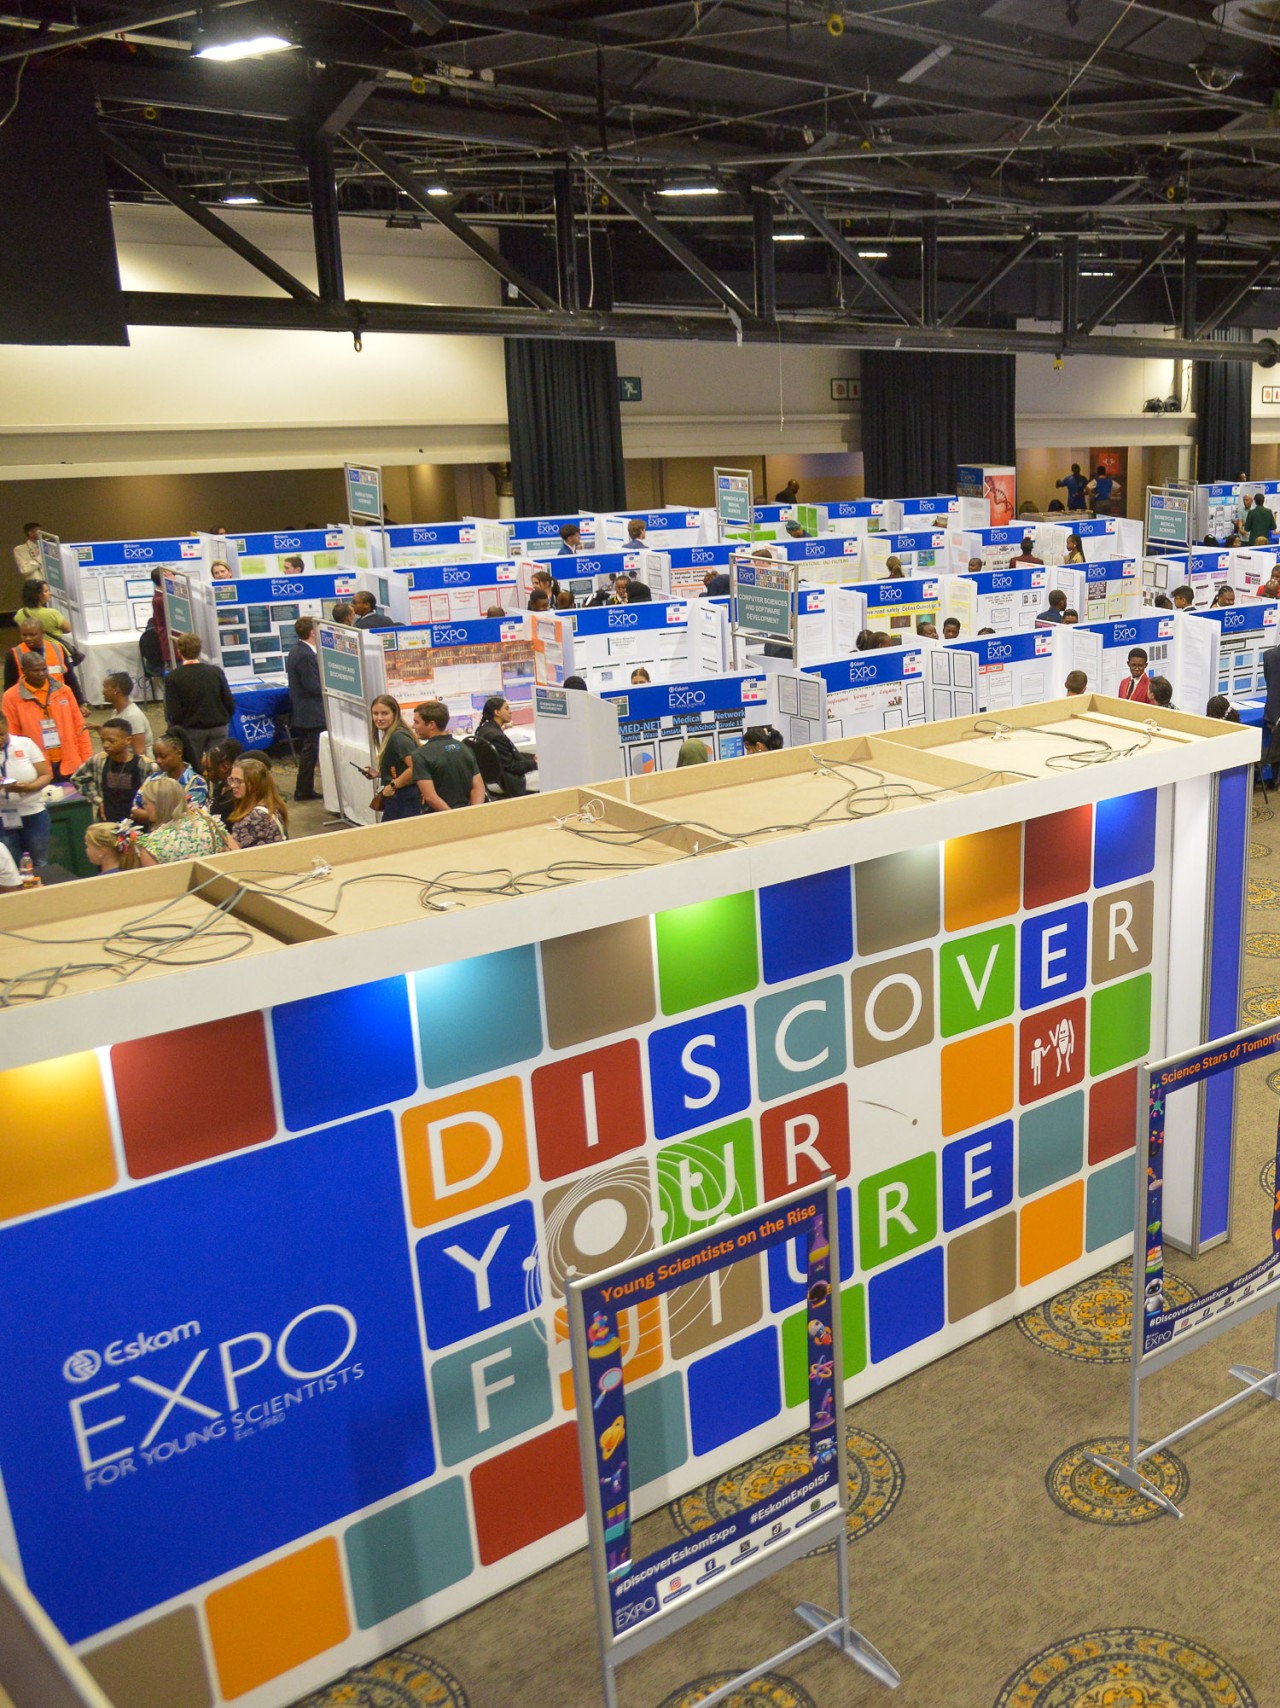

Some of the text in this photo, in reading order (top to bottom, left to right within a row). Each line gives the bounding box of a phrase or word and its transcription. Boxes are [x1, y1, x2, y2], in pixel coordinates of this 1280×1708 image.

[839, 505, 856, 515] EXPO
[919, 502, 935, 511] EXPO
[648, 517, 668, 527] EXPO
[537, 524, 560, 534] EXPO
[1078, 525, 1094, 534] EXPO
[413, 531, 438, 542] EXPO
[990, 532, 1009, 542] EXPO
[273, 538, 301, 549] EXPO
[897, 538, 916, 548] EXPO
[123, 547, 155, 559] EXPO
[805, 545, 826, 555] EXPO
[691, 551, 715, 562] EXPO
[576, 560, 601, 572] EXPO
[1088, 567, 1107, 577] EXPO
[443, 571, 471, 582] EXPO
[739, 571, 755, 580] EXPO
[992, 575, 1013, 587] EXPO
[271, 583, 305, 596] EXPO
[880, 589, 902, 600] EXPO
[738, 594, 788, 607] COMPUTER SCIENCES
[755, 605, 780, 615] SOFTWARE
[886, 606, 900, 614] safety
[608, 613, 638, 626] EXPO
[746, 613, 780, 624] DEVELOPMENT
[1224, 613, 1245, 626] EXPO
[433, 628, 468, 643] EXPO
[1113, 627, 1137, 640] EXPO
[987, 645, 1012, 659] EXPO
[849, 665, 877, 680] EXPO
[668, 690, 706, 707] EXPO
[619, 709, 746, 734] MED-NET Medical Network
[243, 719, 275, 740] EXP
[686, 724, 717, 733] HighSchool
[429, 898, 1141, 1199] DISCOVER
[1161, 1063, 1201, 1086] Science
[1202, 1052, 1228, 1069] Stars
[1229, 1044, 1241, 1058] of
[443, 1112, 830, 1313] YOUR
[601, 1203, 816, 1304] Young Scientists on the Rise
[1149, 1251, 1280, 1327] #DiscoverEskomExpo #EskomExpoISF
[104, 1318, 202, 1368] Eskom
[1145, 1330, 1172, 1350] EXPO
[69, 1303, 358, 1473] EXPO
[84, 1362, 365, 1493] FOR YOUNG SCIENTISTS
[615, 1471, 831, 1597] #DiscoverEskomExpo #EskomExpoISF
[615, 1596, 656, 1630] EXPO
